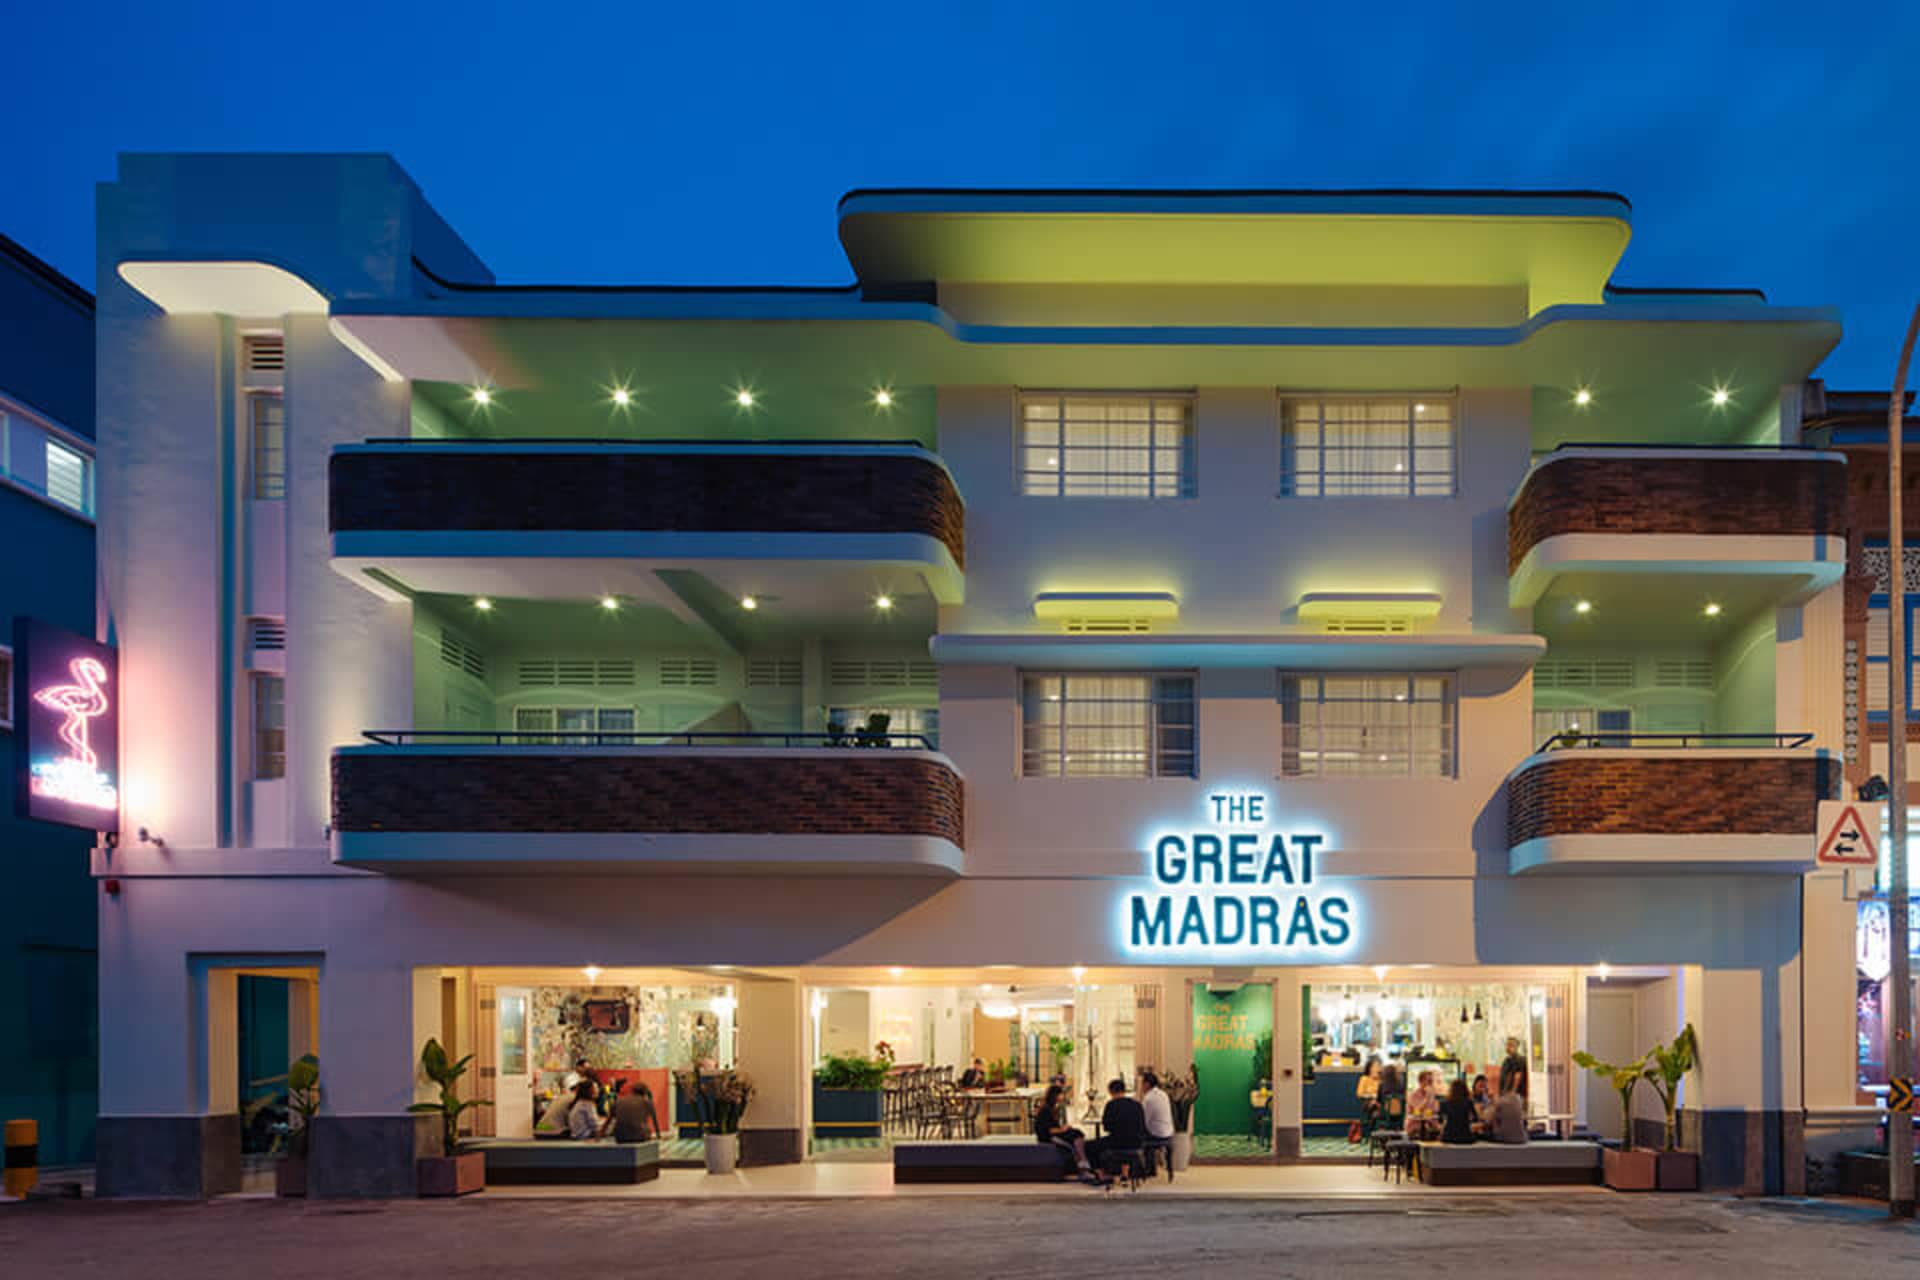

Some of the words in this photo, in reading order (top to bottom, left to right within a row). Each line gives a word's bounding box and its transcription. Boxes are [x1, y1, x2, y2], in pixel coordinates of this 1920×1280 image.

[1211, 795, 1264, 821] THE
[1156, 834, 1323, 884] GREAT
[1131, 895, 1350, 946] MADRAS
